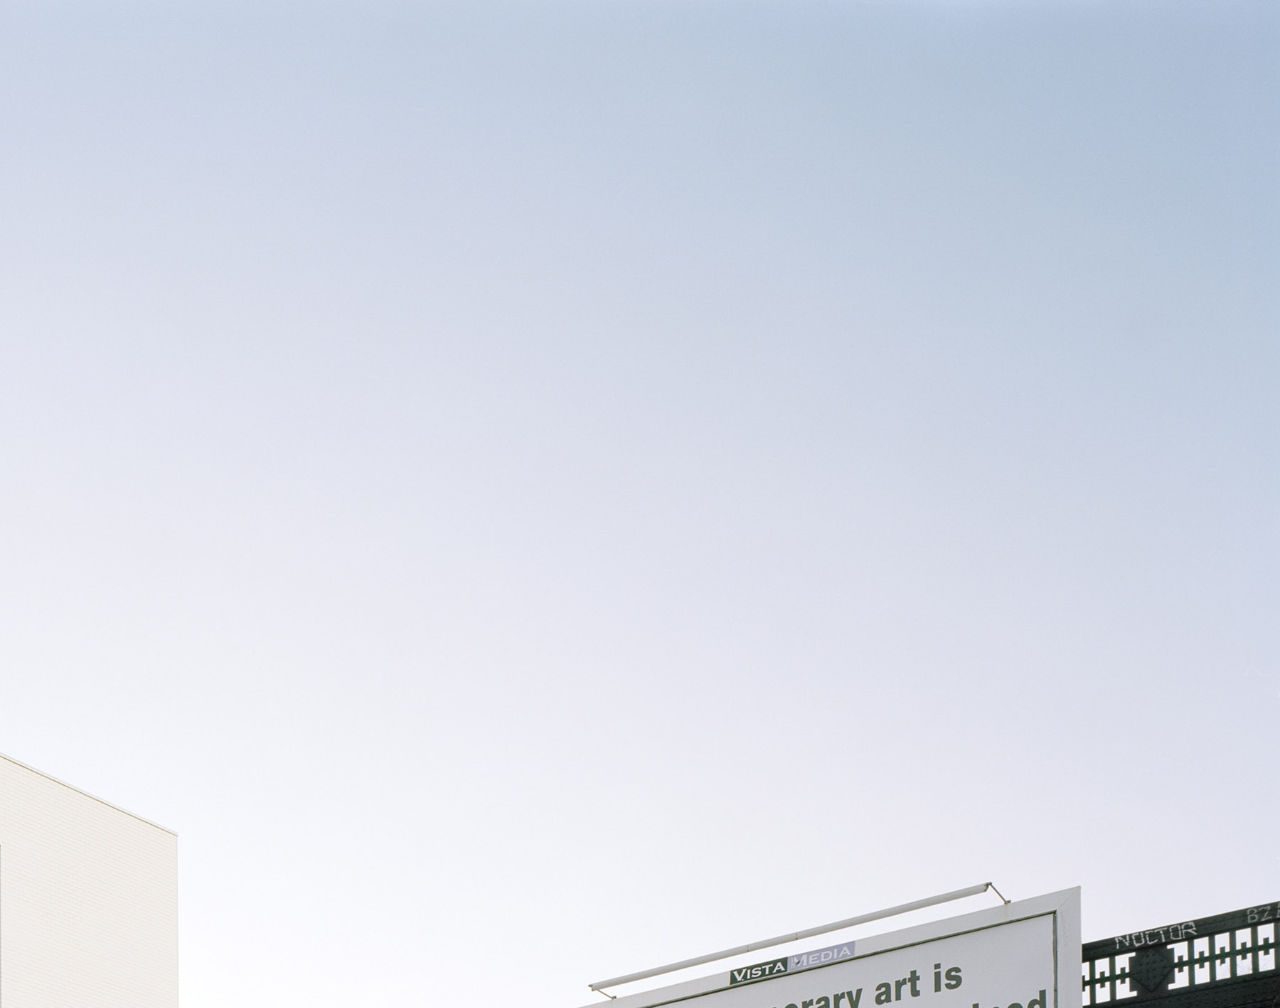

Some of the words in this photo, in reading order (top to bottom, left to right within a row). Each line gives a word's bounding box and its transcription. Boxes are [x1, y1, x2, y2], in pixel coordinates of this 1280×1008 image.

[733, 962, 786, 981] VISTA
[791, 946, 851, 967] MEDIA
[874, 969, 921, 1006] art
[933, 963, 963, 993] is
